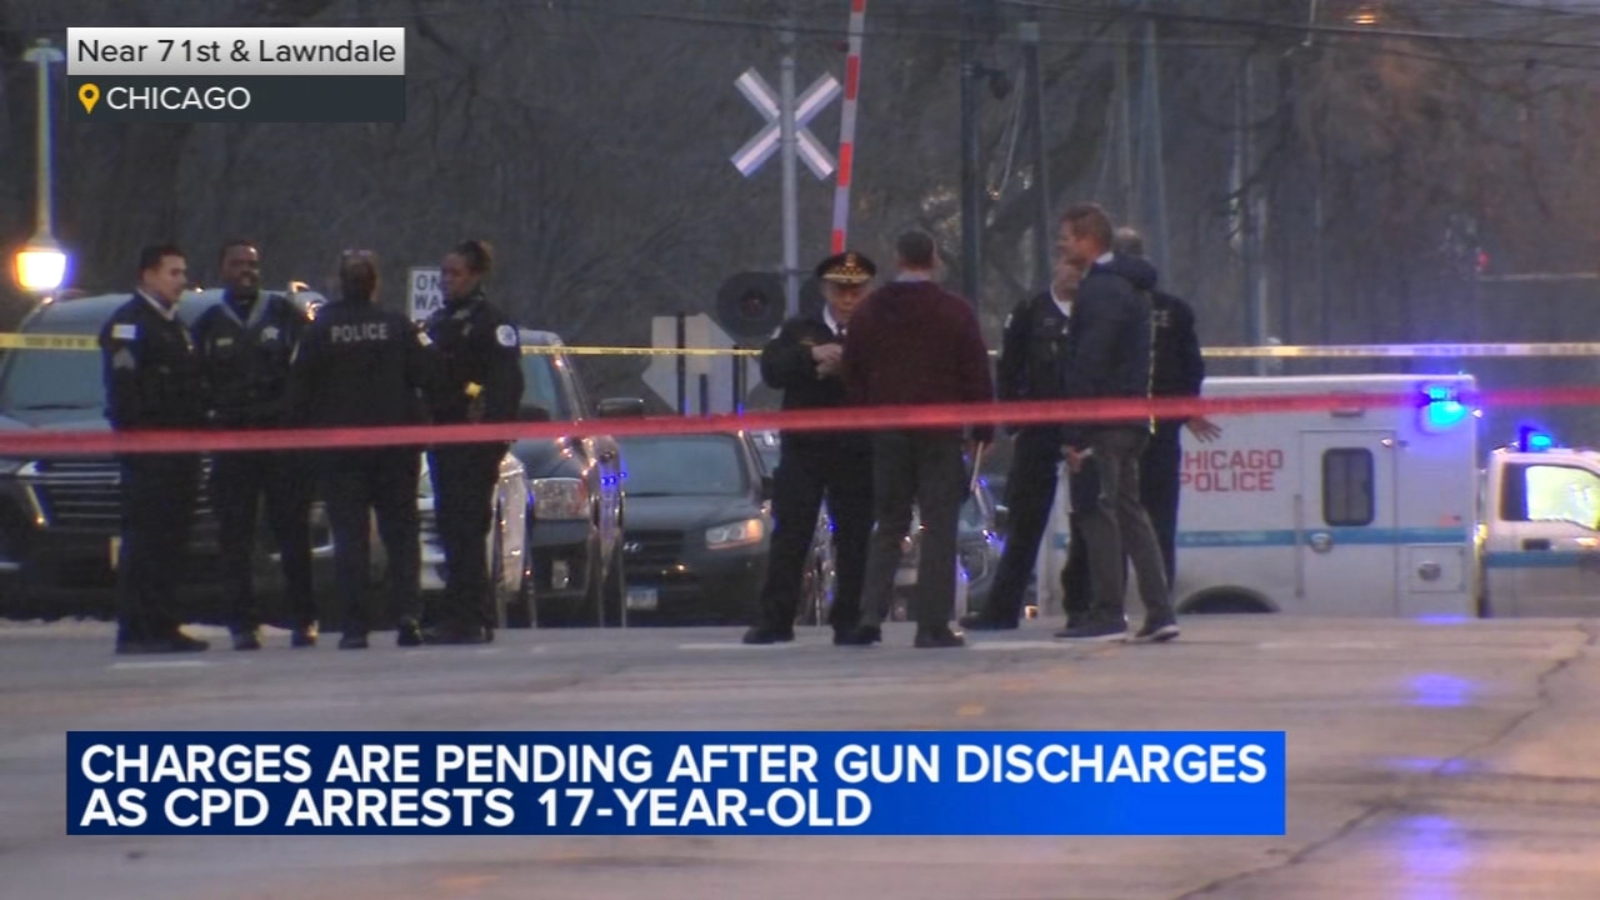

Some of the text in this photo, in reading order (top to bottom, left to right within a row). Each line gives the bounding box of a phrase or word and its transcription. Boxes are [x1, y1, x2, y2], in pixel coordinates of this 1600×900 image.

[416, 274, 442, 291] ON
[415, 294, 441, 310] WA
[331, 323, 388, 342] POLICE
[1182, 449, 1284, 470] HICAGO
[1178, 471, 1275, 492] POLICE
